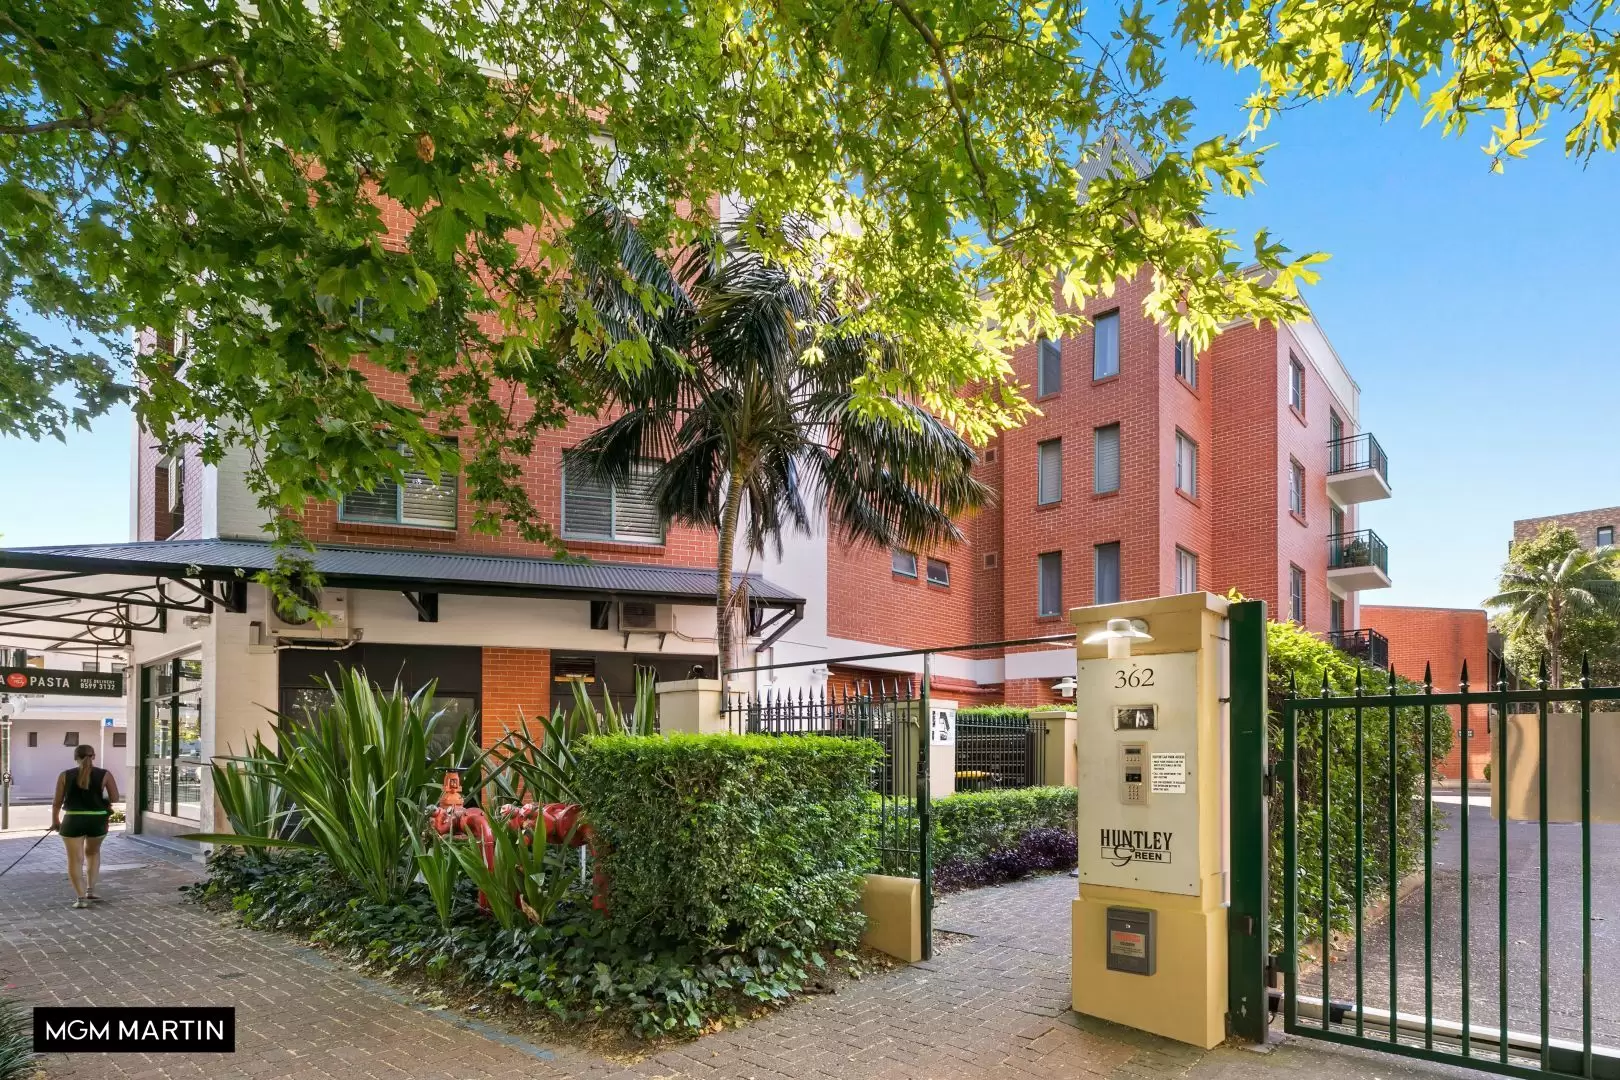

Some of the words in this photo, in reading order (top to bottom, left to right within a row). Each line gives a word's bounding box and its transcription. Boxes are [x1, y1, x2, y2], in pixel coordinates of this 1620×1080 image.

[30, 676, 70, 688] PASTA
[1114, 668, 1155, 689] 362
[1100, 828, 1173, 851] HUNTLEY
[1110, 843, 1162, 867] GREEN
